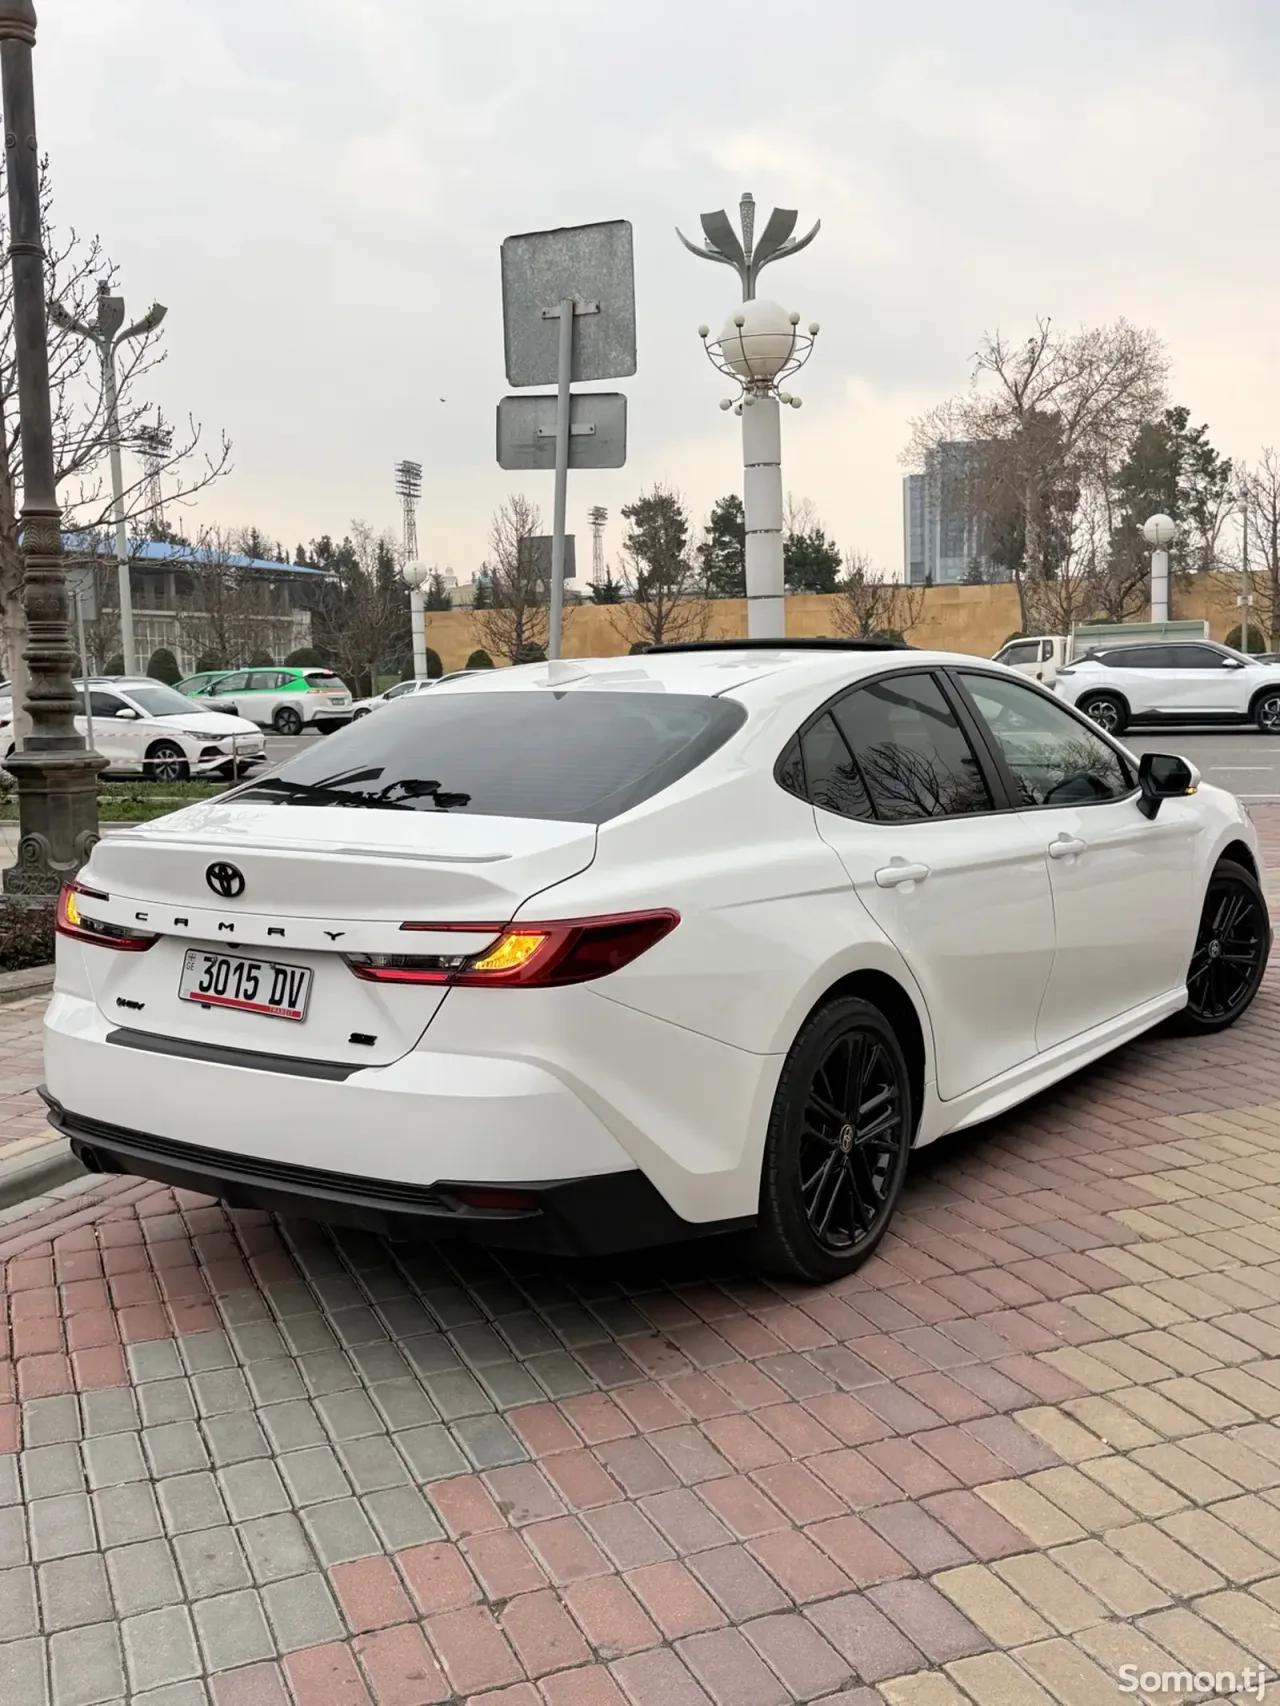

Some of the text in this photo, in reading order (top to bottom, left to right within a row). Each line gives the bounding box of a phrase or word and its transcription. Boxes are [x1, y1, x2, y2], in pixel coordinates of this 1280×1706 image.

[135, 911, 346, 941] CAMRY
[199, 956, 305, 1009] 3015 DV
